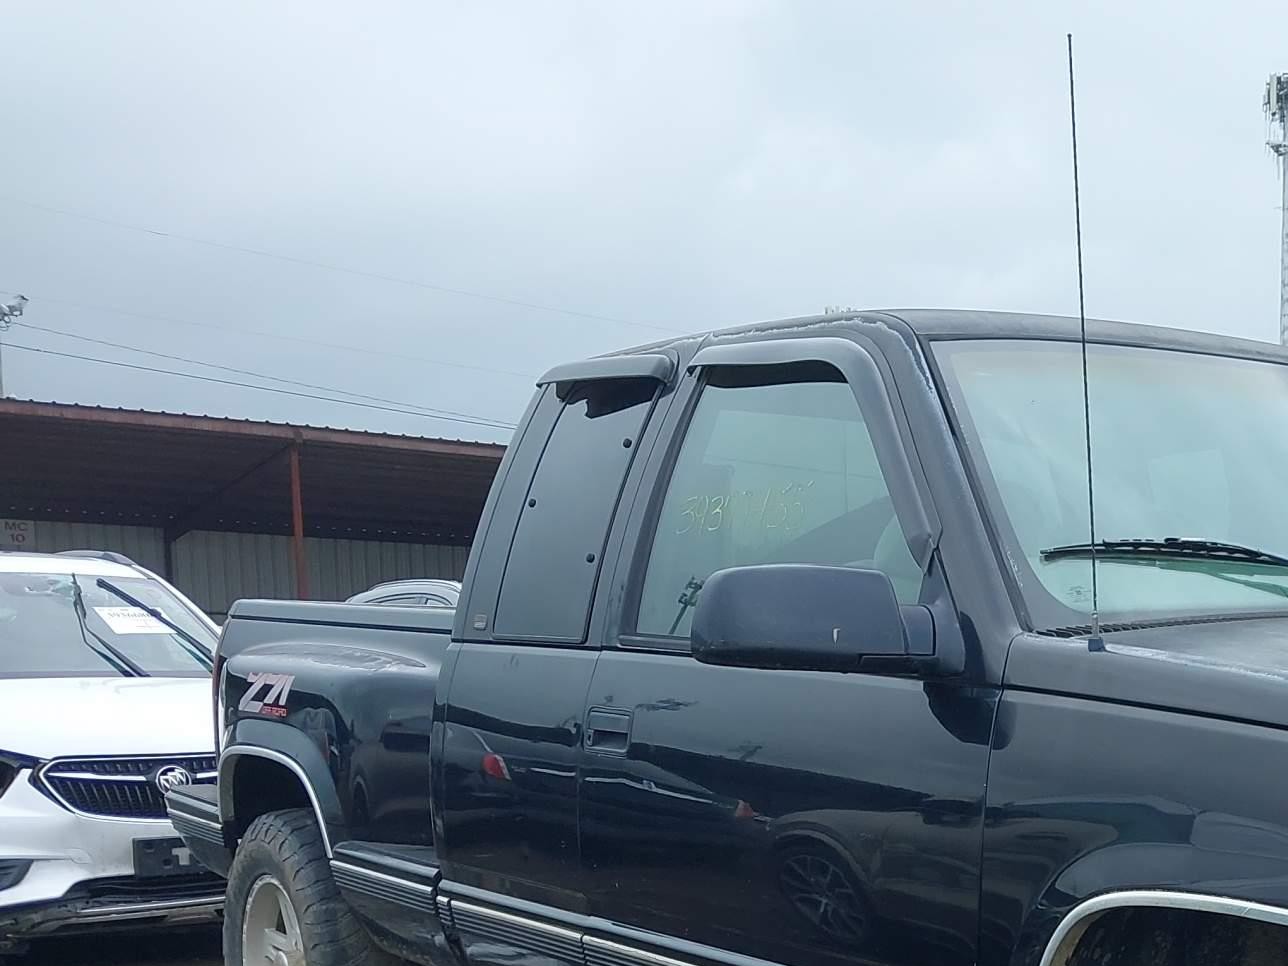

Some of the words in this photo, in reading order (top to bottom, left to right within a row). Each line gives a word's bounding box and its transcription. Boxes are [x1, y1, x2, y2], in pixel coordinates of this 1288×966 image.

[4, 521, 28, 531] MC
[10, 533, 26, 544] 10
[238, 672, 295, 713] Z71
